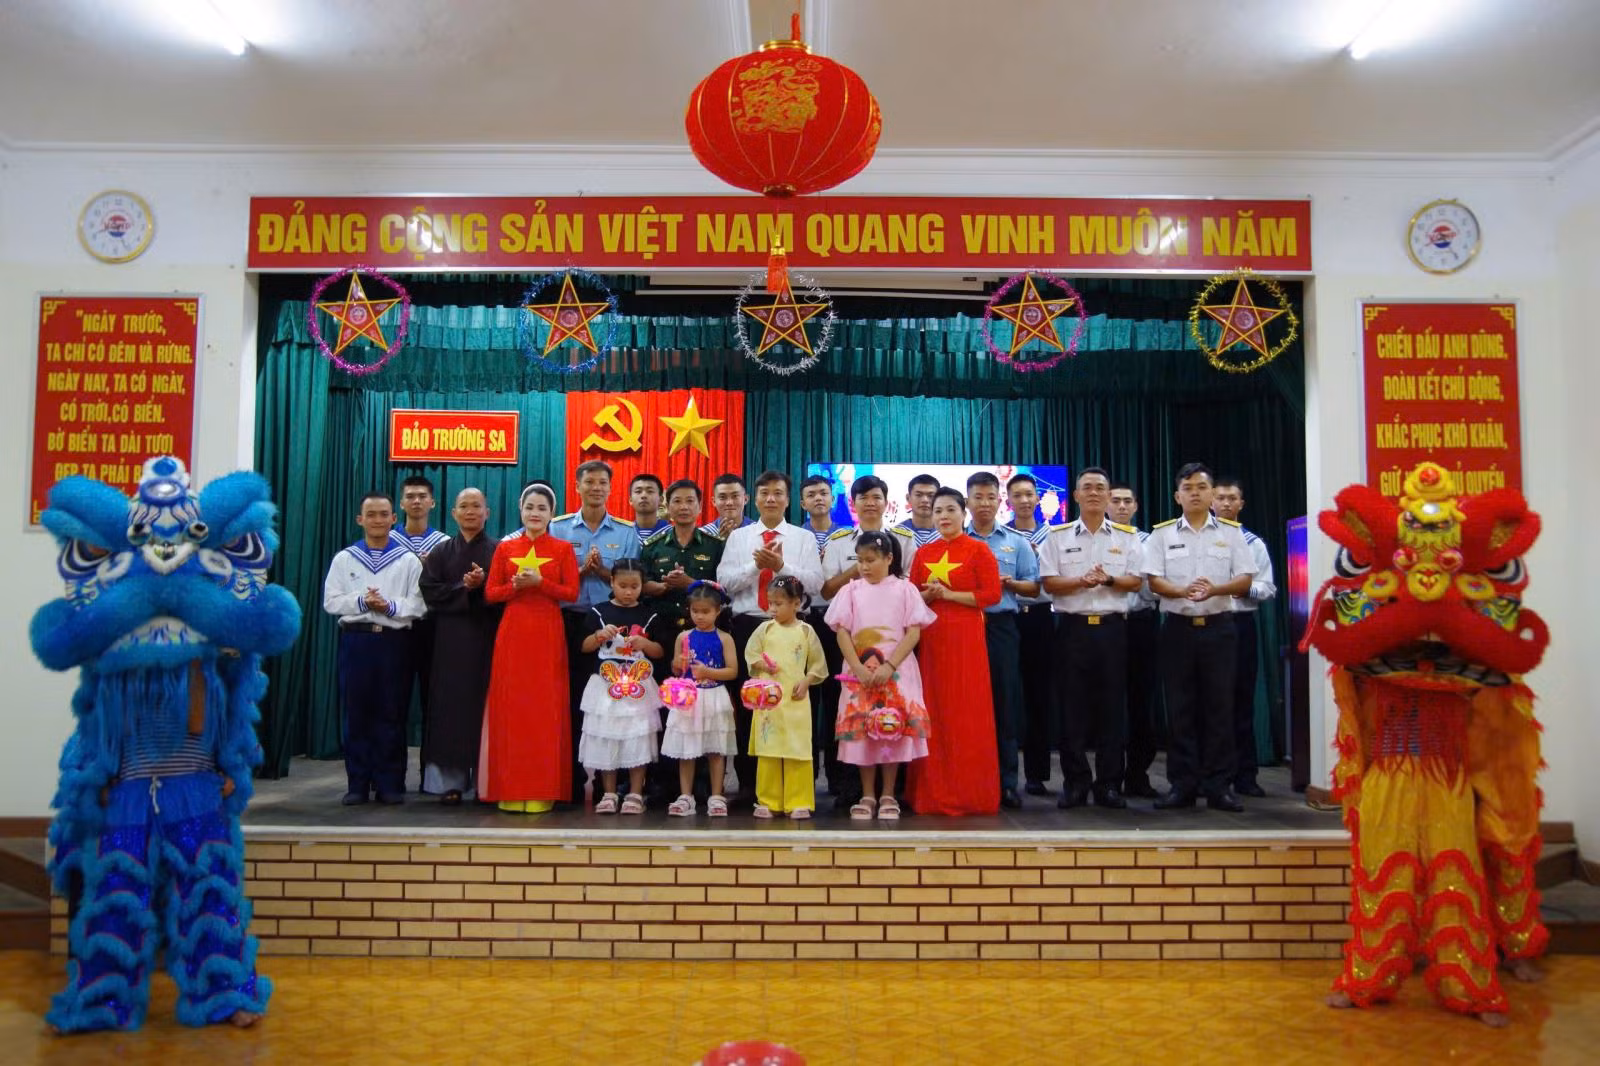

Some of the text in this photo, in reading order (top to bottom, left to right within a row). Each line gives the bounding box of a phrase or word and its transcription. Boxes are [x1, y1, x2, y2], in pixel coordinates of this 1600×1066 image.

[257, 200, 1297, 260] ĐẢNG CỘNG SẢN VIỆT NAM QUANG VINH MUÔN NĂM
[46, 343, 61, 362] TA
[64, 336, 85, 361] CHỈ
[87, 340, 105, 362] CÓ
[108, 341, 137, 363] ĐÊM
[139, 341, 153, 364] VÀ
[1376, 326, 1413, 359] CHIẾN
[1415, 326, 1440, 359] ĐẤU
[1443, 333, 1468, 358] ANH
[47, 369, 186, 395] NGÀY NAY, TA CÓ NGÀY,
[1383, 371, 1416, 401] ĐOÀN
[1418, 368, 1440, 400] KẾT
[1441, 365, 1465, 401] CHỦ
[60, 398, 77, 422] CÓ
[133, 395, 166, 423] BIỂN.
[47, 428, 64, 451] BỜ
[68, 425, 97, 452] BIỂN
[101, 434, 116, 453] TA
[145, 434, 174, 454] TƯƠI
[402, 421, 507, 452] ĐẢO TRƯỜNG SA
[1376, 413, 1409, 449] KHẮC
[1411, 423, 1441, 454] PHỤC
[1443, 418, 1468, 449] KHÓ
[1379, 465, 1402, 496] GIỮ
